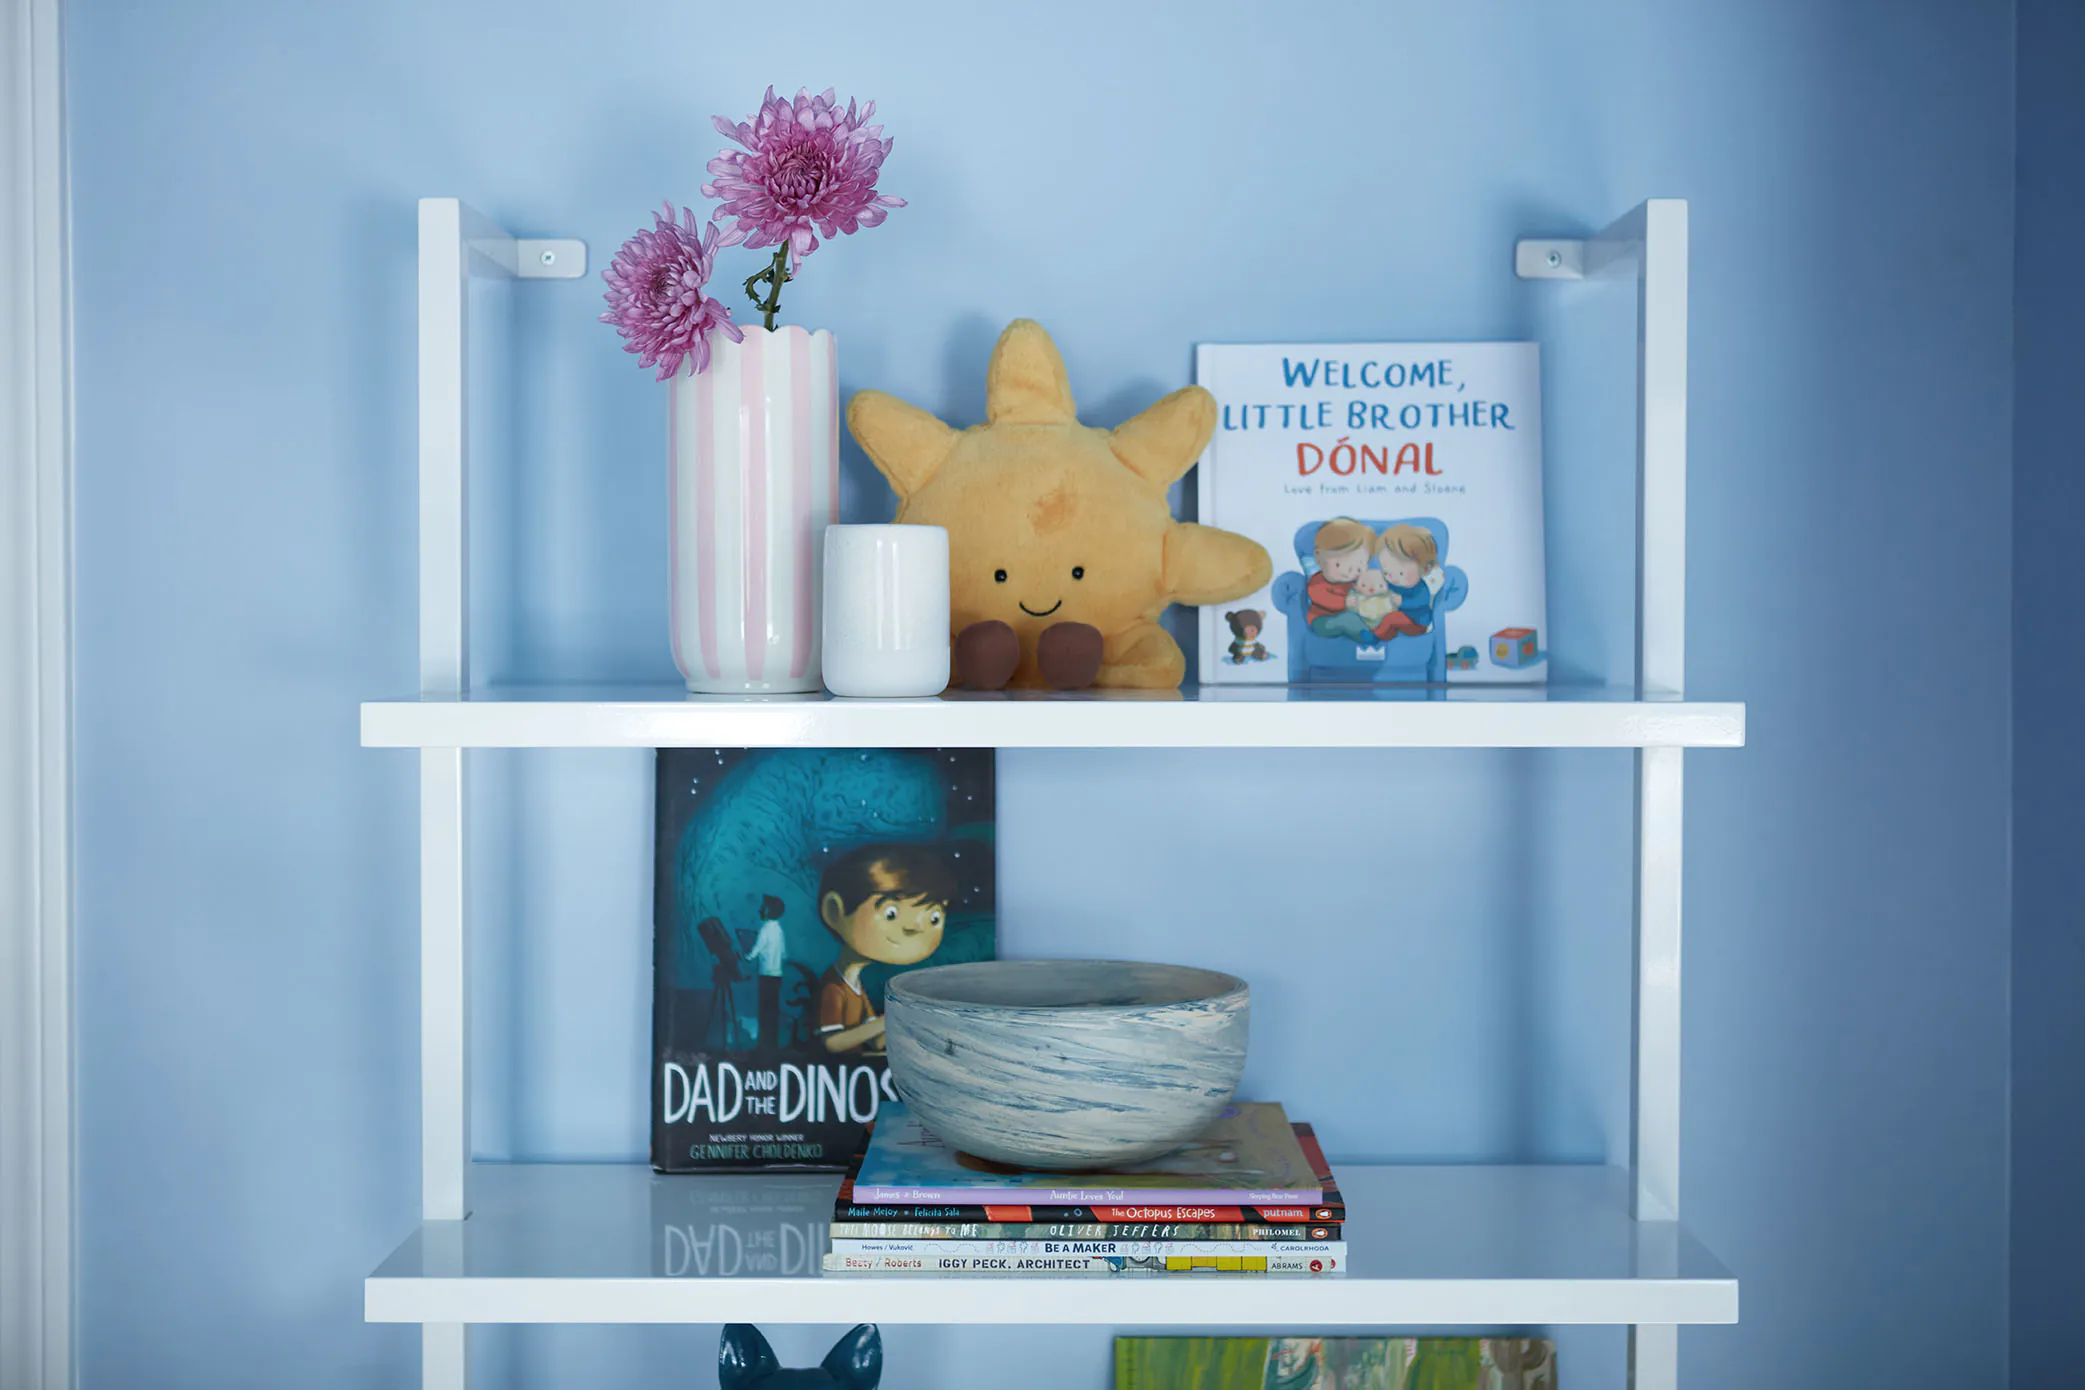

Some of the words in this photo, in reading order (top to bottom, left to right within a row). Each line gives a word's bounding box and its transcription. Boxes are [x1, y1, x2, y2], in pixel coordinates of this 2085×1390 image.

[1282, 357, 1466, 392] WELCOME,
[1222, 401, 1333, 431] LITTLE
[1347, 400, 1516, 431] BROTHER
[1296, 436, 1444, 476] DÓNAL
[1284, 483, 1312, 495] Love
[1319, 483, 1349, 495] from
[1356, 483, 1388, 495] Liam
[1394, 483, 1417, 495] and
[1423, 482, 1467, 495] Sloane
[744, 1070, 778, 1092] AND
[663, 1062, 743, 1124] DAD
[744, 1096, 777, 1116] THE
[1080, 1190, 1103, 1200] Loves
[848, 1207, 870, 1217] Maile
[914, 1206, 942, 1217] Felicita
[945, 1207, 960, 1217] Sala
[1111, 1208, 1125, 1217] The
[1126, 1207, 1173, 1220] Octopus
[1176, 1206, 1216, 1220] Escapes
[1263, 1208, 1303, 1219] putnam
[1049, 1224, 1103, 1237] OLIVER
[1112, 1224, 1180, 1238] JEFFERS
[1252, 1228, 1302, 1237] PHILOMEL
[884, 1257, 922, 1268] Roberts
[938, 1258, 968, 1269] IGGY
[1017, 1258, 1091, 1270] ARCHITECT
[1271, 1262, 1304, 1270] ABRAMS
